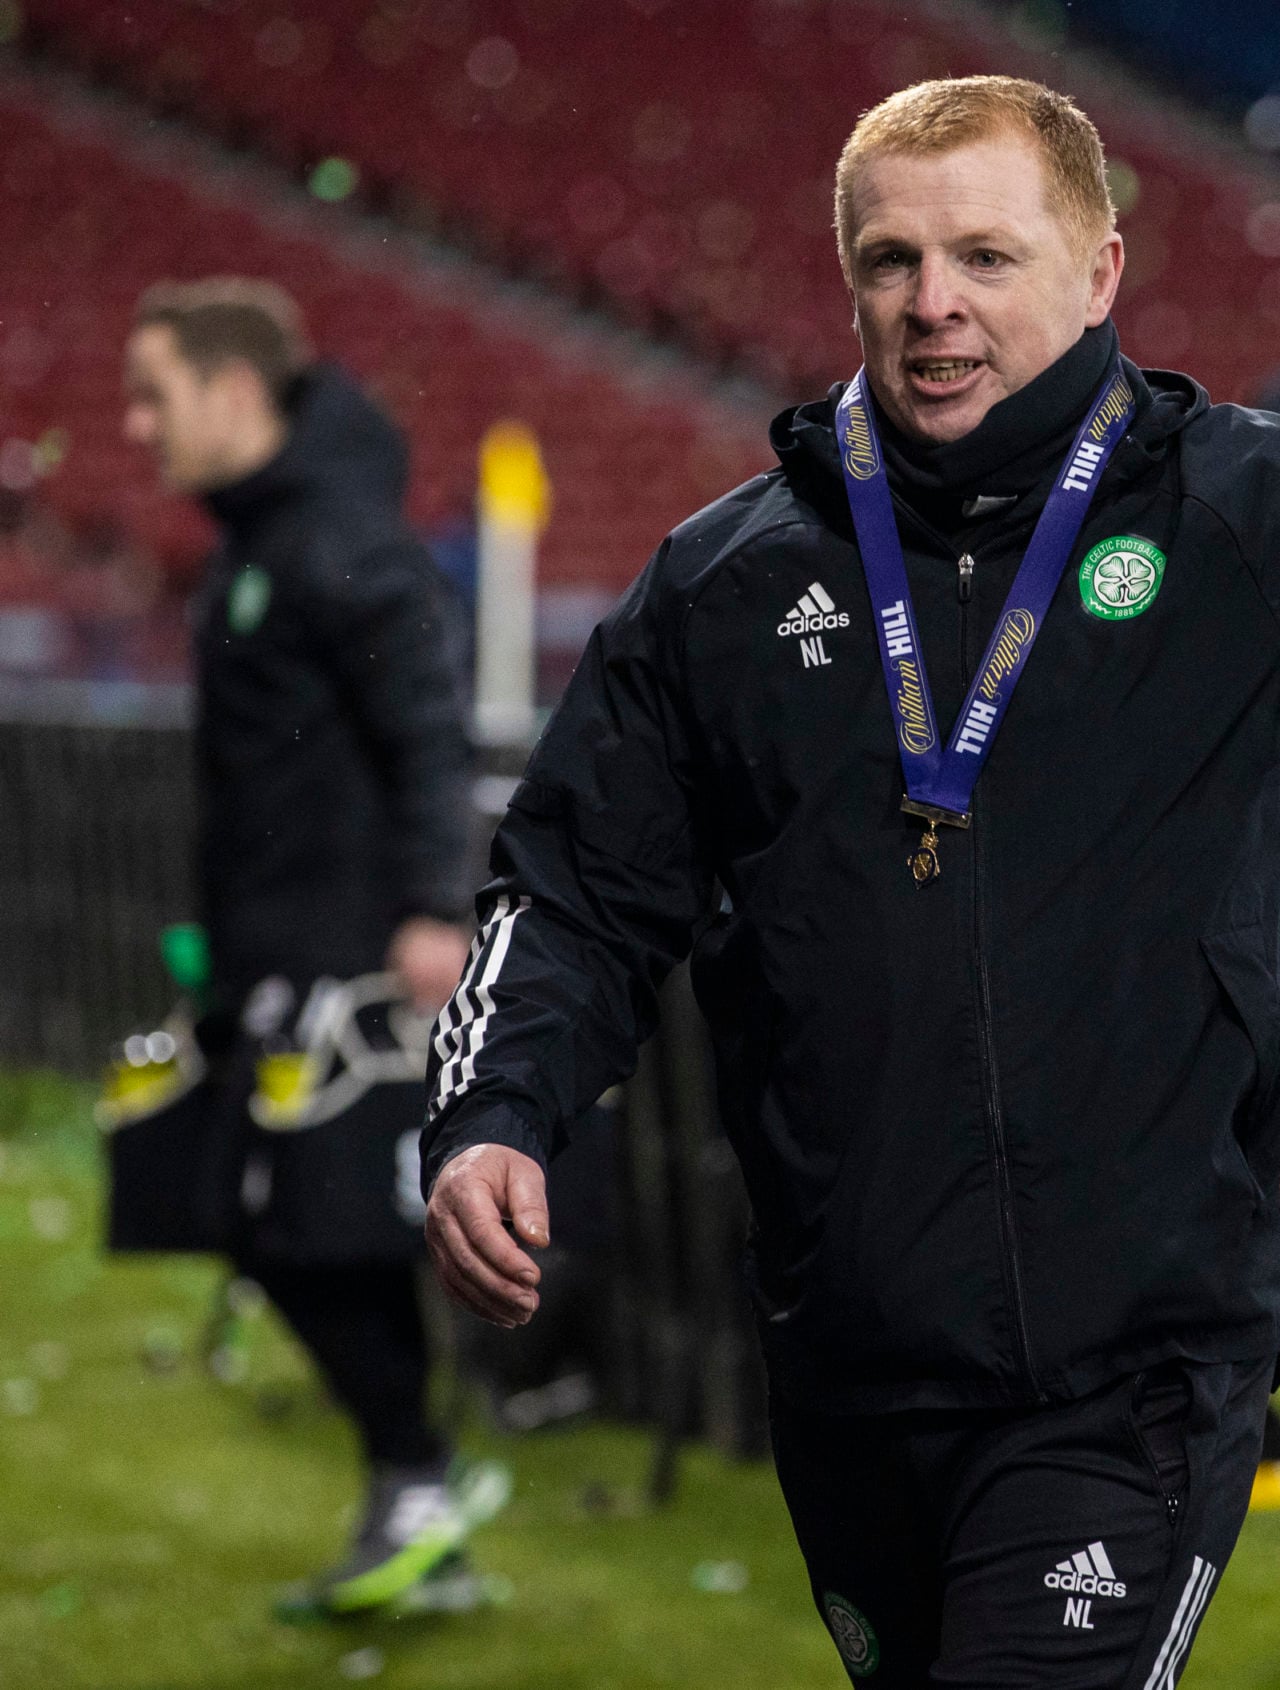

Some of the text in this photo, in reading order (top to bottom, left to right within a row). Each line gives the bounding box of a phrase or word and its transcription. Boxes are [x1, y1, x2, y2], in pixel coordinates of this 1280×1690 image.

[844, 405, 880, 481] William
[1062, 374, 1135, 492] William HILL
[1082, 539, 1157, 580] THE CELTIC FOOTBALL
[777, 612, 850, 637] adidas
[1114, 607, 1135, 617] 1888
[799, 635, 832, 668] NL
[881, 600, 935, 755] William HILL
[955, 608, 1035, 755] William HILL
[1044, 1571, 1126, 1598] adidas
[1063, 1597, 1094, 1630] NL
